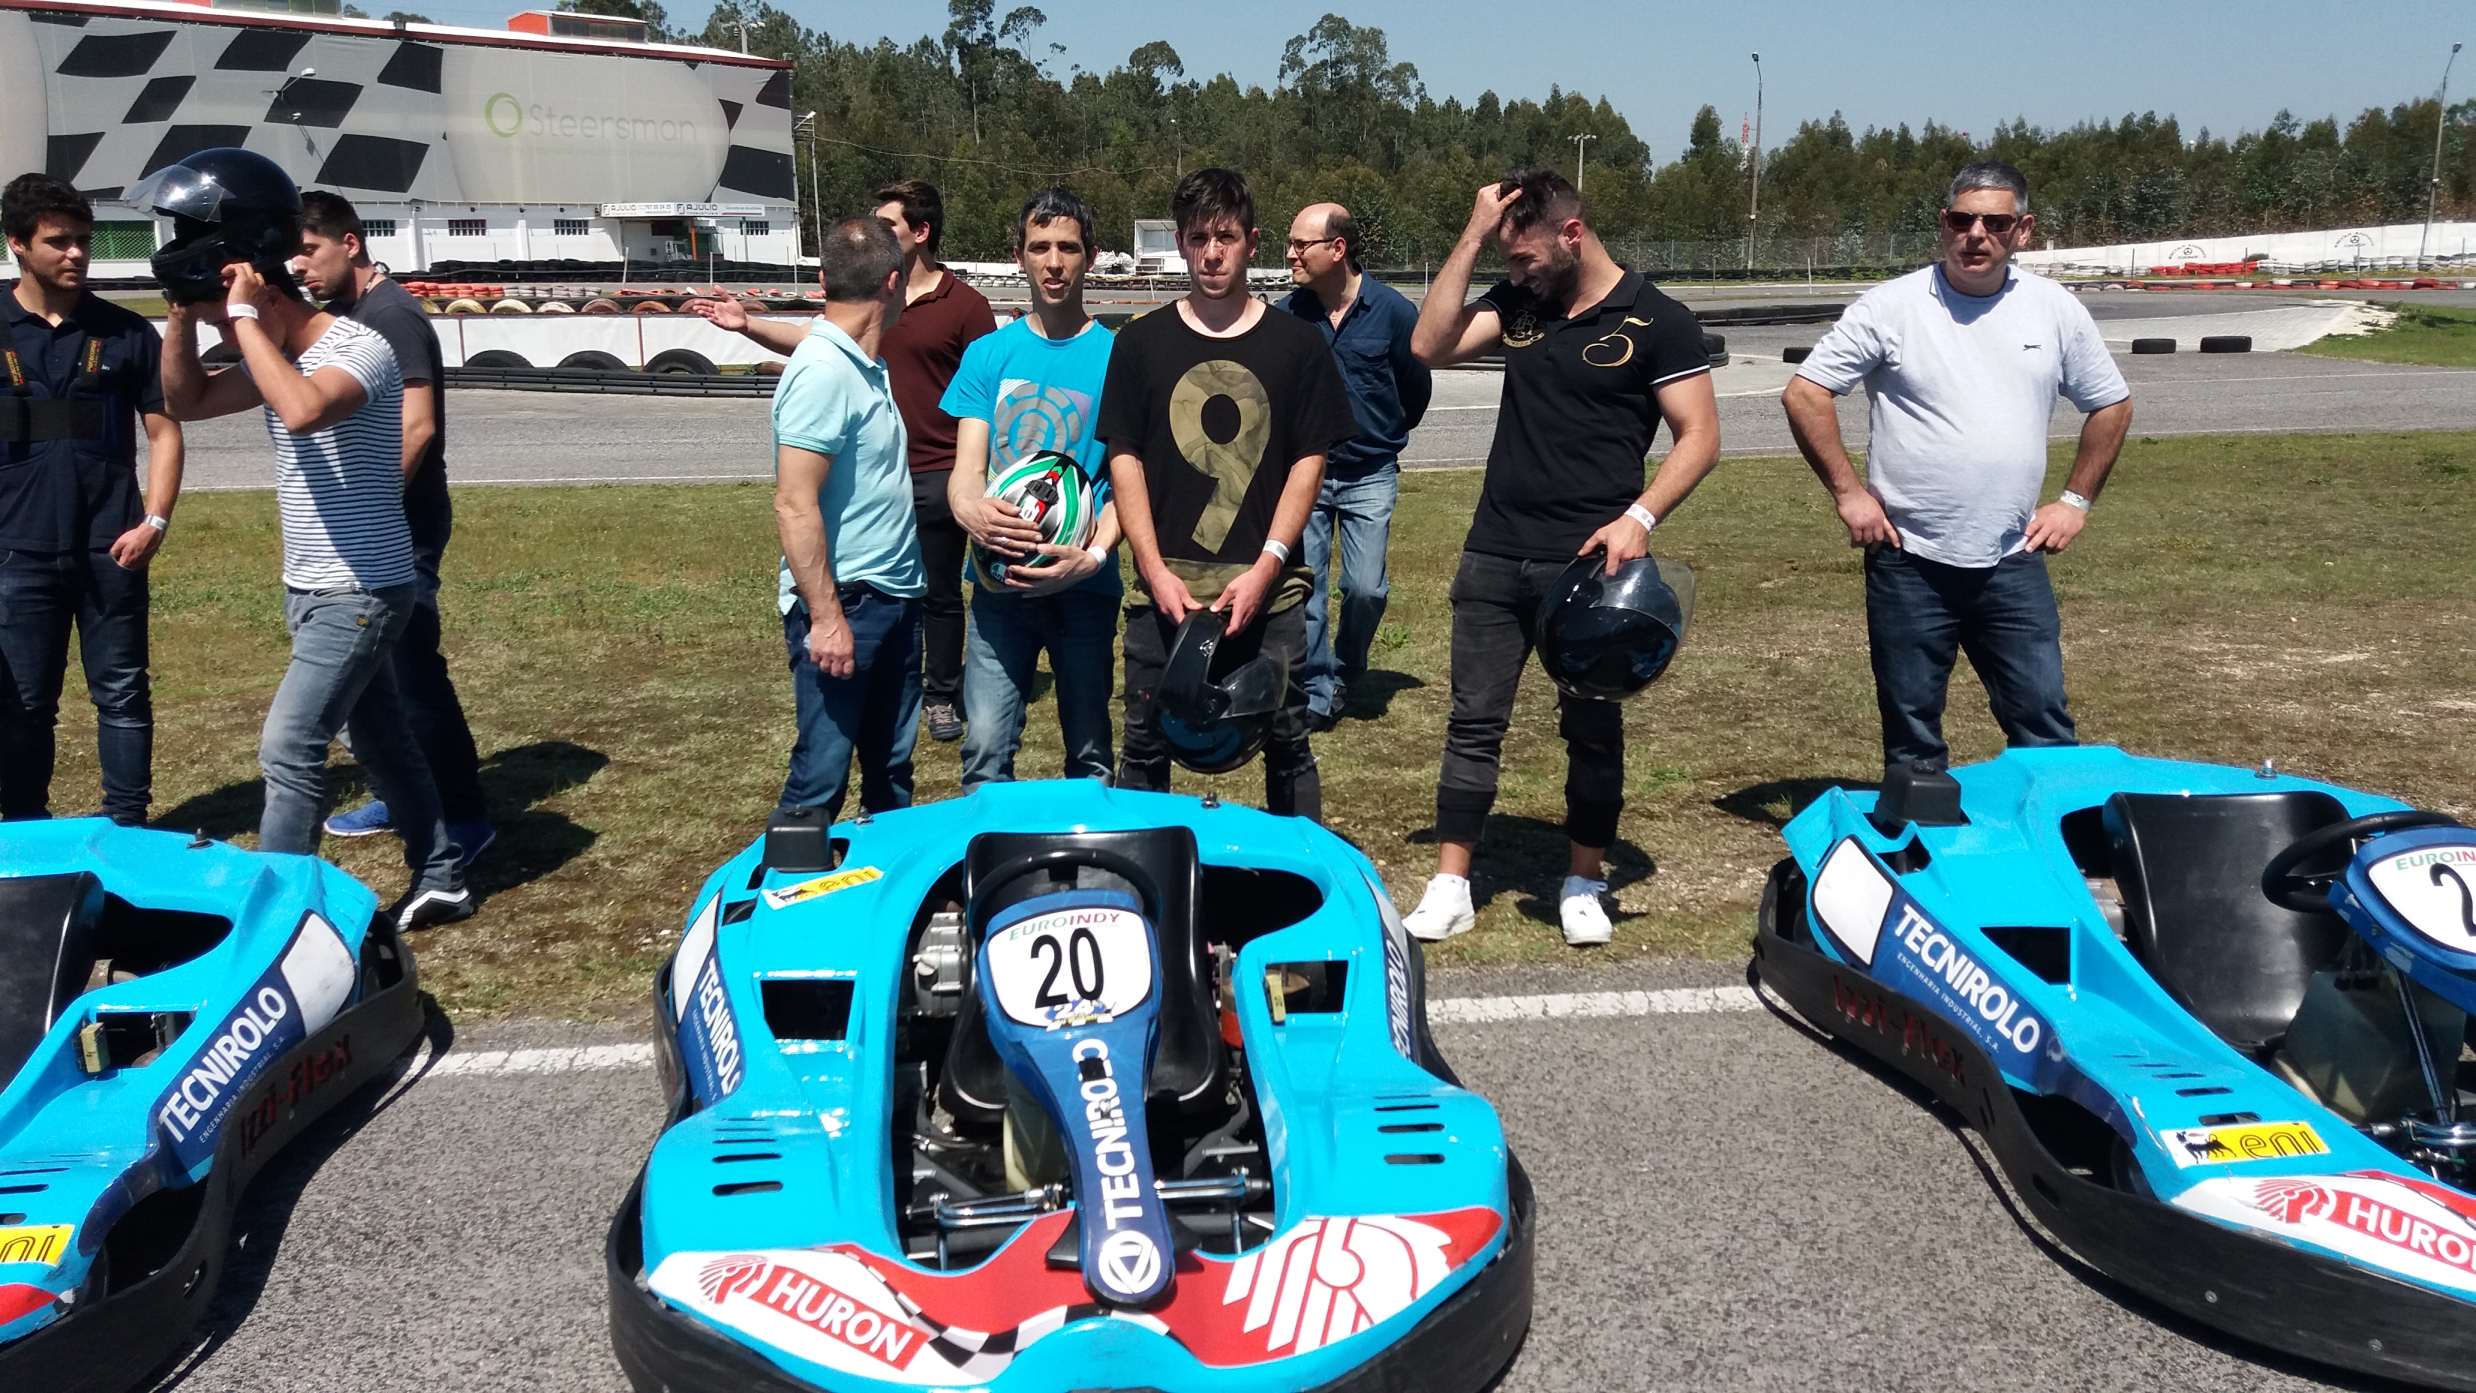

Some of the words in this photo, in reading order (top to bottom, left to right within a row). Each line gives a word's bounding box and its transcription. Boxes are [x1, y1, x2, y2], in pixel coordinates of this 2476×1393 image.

[528, 103, 697, 142] Steersman
[1169, 359, 1272, 556] 9
[1009, 912, 1120, 941] EUROINDY
[2429, 862, 2476, 937] 2
[1030, 927, 1105, 1009] 20
[1386, 939, 1411, 1058] CNIROLO
[1894, 903, 2041, 1053] TECNIROLO
[1897, 952, 1940, 996] ENGENHARIA
[158, 986, 287, 1144] TECNIROLO
[199, 1096, 238, 1144] ENGENHARIA
[2239, 1130, 2320, 1160] eni
[2347, 1196, 2476, 1270] HURO
[767, 1271, 913, 1362] HURON
